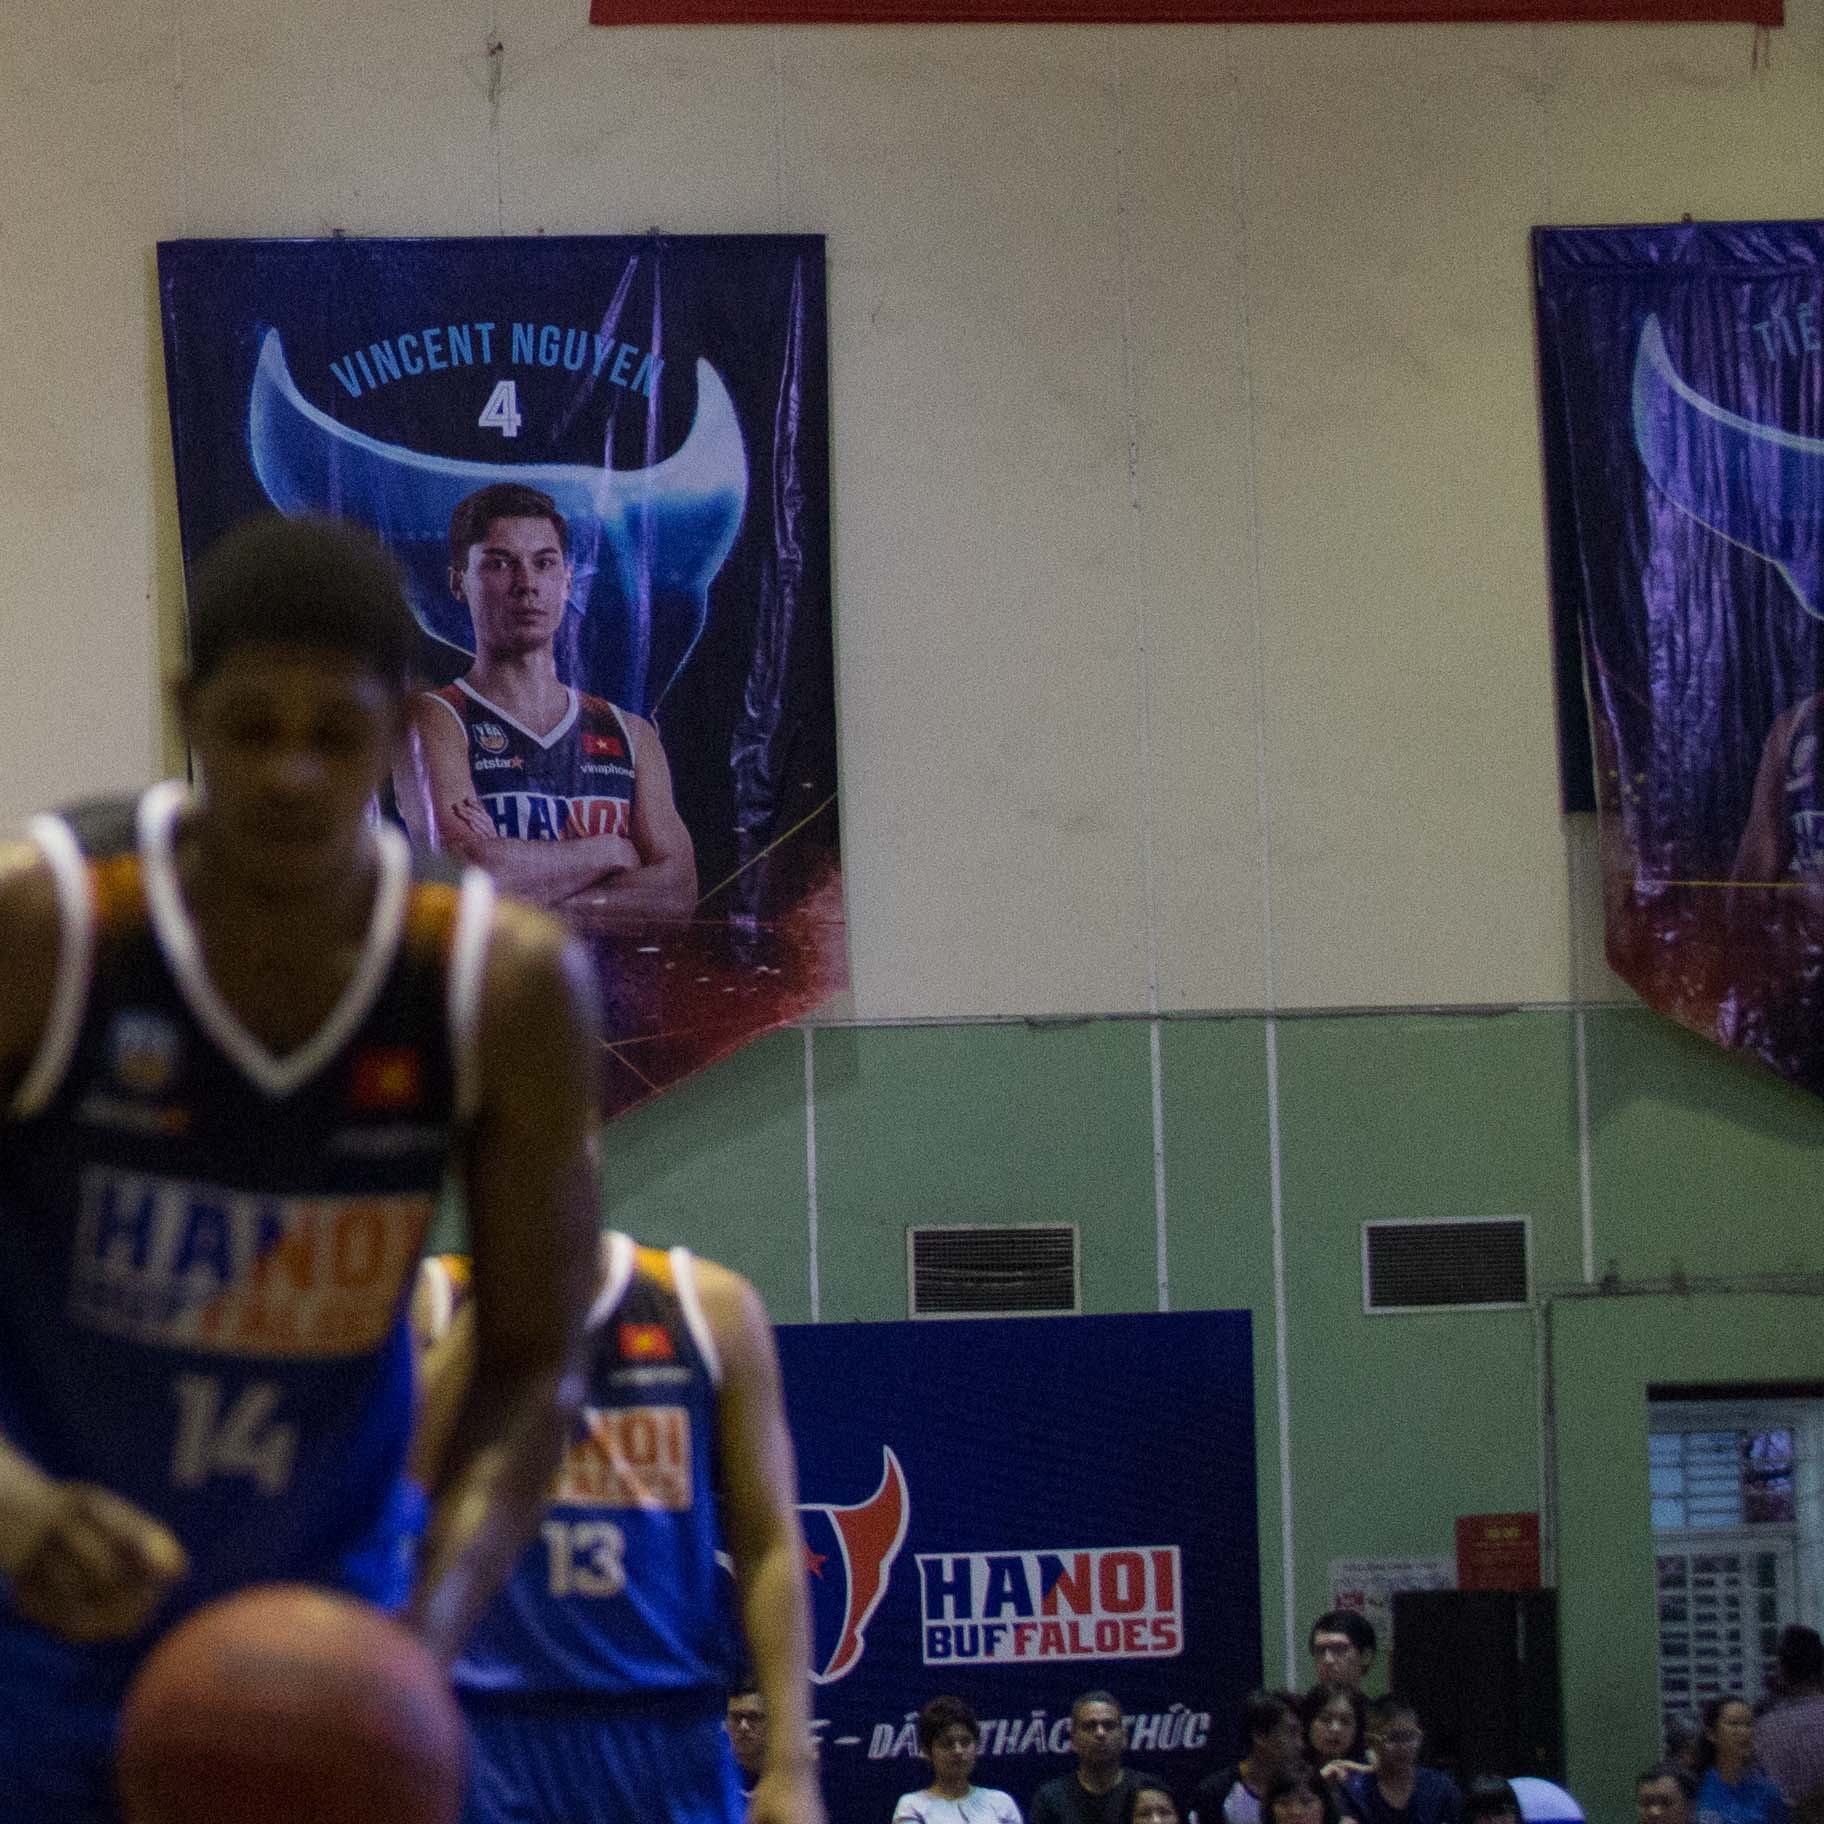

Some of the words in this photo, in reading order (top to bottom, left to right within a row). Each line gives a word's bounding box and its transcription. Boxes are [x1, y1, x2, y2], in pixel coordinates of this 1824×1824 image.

[330, 322, 496, 398] VINCENT
[511, 322, 664, 398] NGUYEN
[478, 380, 522, 438] 4
[474, 757, 514, 771] etstar
[170, 1373, 300, 1497] 14
[541, 1520, 626, 1598] 13
[919, 1550, 1175, 1621] HANOI
[925, 1616, 1177, 1660] BUFFALOES
[867, 1710, 931, 1761] DÁ
[977, 1709, 1073, 1756] THÁC
